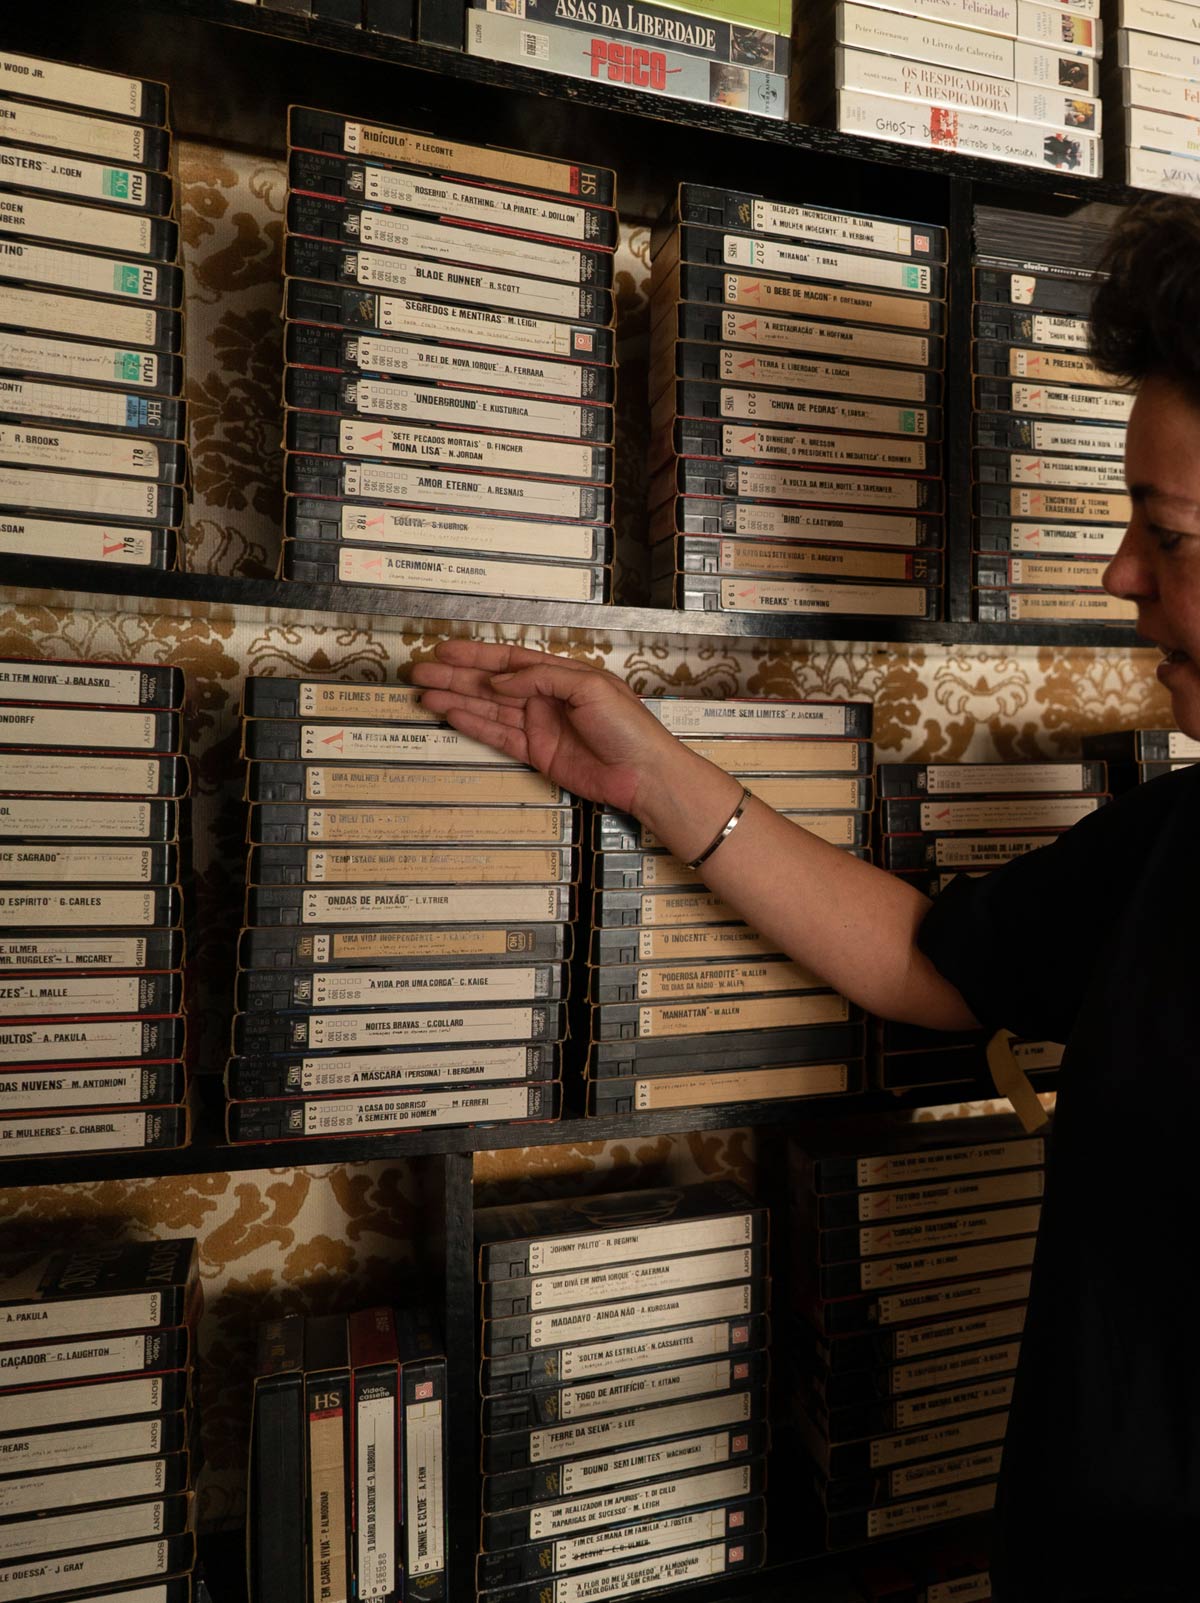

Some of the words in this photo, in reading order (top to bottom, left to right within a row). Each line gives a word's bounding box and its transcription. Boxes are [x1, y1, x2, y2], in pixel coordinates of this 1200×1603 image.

[962, 0, 1009, 19] Felicidade
[555, 0, 597, 23] ASAS
[601, 5, 625, 27] DA
[628, 10, 716, 49] LIBERDADE
[526, 34, 536, 56] STEREO
[922, 37, 929, 45] O
[932, 39, 953, 50] Livro
[955, 44, 965, 52] de
[4, 62, 29, 75] WOOD
[32, 68, 45, 79] JR.
[591, 39, 666, 90] PSICO
[901, 66, 919, 79] OS
[921, 69, 1011, 97] RESPIGADORES
[904, 81, 911, 93] E
[912, 84, 922, 96] A
[922, 85, 1009, 112] RESPIGADORA
[876, 118, 914, 135] GHOST
[993, 142, 1002, 150] DO
[132, 175, 142, 201] FUJI
[580, 172, 596, 195] HS
[461, 194, 494, 208] FARTHING
[549, 211, 575, 223] DOILLON
[756, 243, 764, 265] 207
[143, 269, 152, 296] FUJI
[728, 277, 737, 299] 206
[919, 268, 927, 290] FUJI
[793, 289, 801, 298] DE
[727, 313, 736, 336] 205
[143, 356, 153, 383] FUJI
[426, 354, 438, 363] REI
[440, 355, 448, 364] DE
[452, 357, 470, 368] NOVA
[514, 366, 544, 377] FERRARA
[724, 352, 732, 375] 204
[490, 404, 528, 416] KUSTURICA
[797, 402, 806, 411] DE
[917, 413, 926, 434] FUJI
[414, 433, 445, 445] PECADOS
[496, 441, 522, 452] FINCHER
[133, 448, 144, 467] 178
[124, 537, 134, 554] 176
[457, 567, 487, 576] CHABROL
[916, 559, 927, 578] HS
[13, 673, 30, 682] TEM
[303, 687, 313, 711] 245
[322, 691, 335, 700] OS
[339, 691, 371, 701] FILMES
[375, 693, 386, 701] DE
[389, 693, 408, 703] MAN
[739, 708, 754, 718] SEM
[305, 729, 314, 755] 244
[389, 733, 399, 743] NA
[360, 896, 371, 905] DE
[10, 945, 37, 953] ULMER
[76, 954, 113, 963] MCCAREY
[377, 979, 393, 989] VIDA
[396, 978, 410, 988] POR
[412, 978, 428, 988] UMA
[29, 989, 37, 997] L.
[39, 989, 68, 997] MALLE
[365, 1021, 390, 1031] NOITES
[393, 1019, 420, 1029] BRAVAS
[54, 1033, 87, 1043] PAKULA
[353, 1071, 359, 1082] A
[366, 1103, 383, 1112] CASA
[385, 1102, 394, 1111] DO
[461, 1098, 489, 1107] FERRERI
[366, 1112, 397, 1122] SEMENTE
[400, 1111, 408, 1120] DO
[3, 1130, 14, 1138] DE
[149, 1294, 158, 1322] SONY
[551, 1314, 591, 1328] MADADAYO
[621, 1306, 635, 1318] NÃO
[66, 1347, 110, 1360] LAUGHTON
[606, 1349, 613, 1357] AS
[151, 1380, 159, 1406] SONY
[313, 1392, 340, 1410] HS
[597, 1388, 605, 1397] DE
[150, 1422, 158, 1449] SONY
[576, 1428, 585, 1438] DA
[154, 1461, 162, 1488] SONY
[641, 1501, 660, 1510] LEIGH
[153, 1504, 161, 1531] SONY
[156, 1542, 164, 1569] SONY
[63, 1562, 84, 1573] GRAY
[321, 1557, 331, 1579] CARNE
